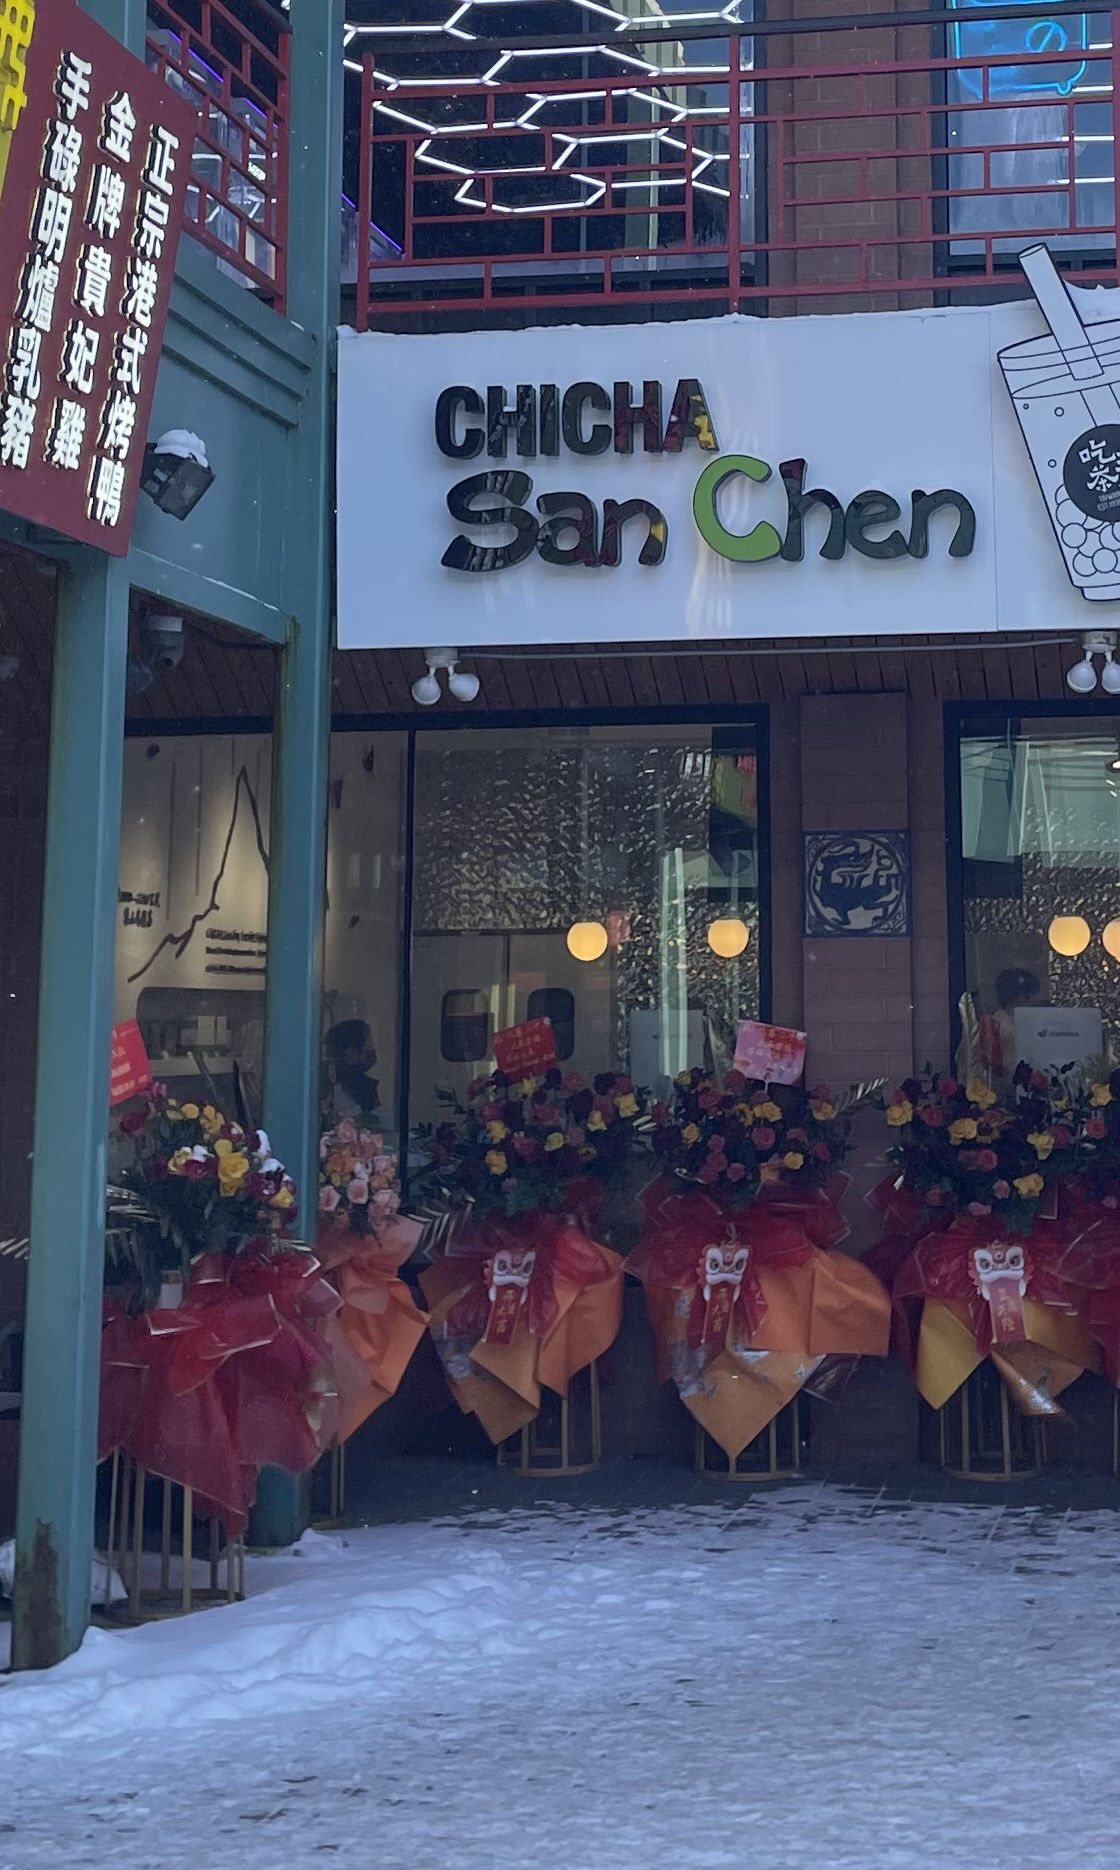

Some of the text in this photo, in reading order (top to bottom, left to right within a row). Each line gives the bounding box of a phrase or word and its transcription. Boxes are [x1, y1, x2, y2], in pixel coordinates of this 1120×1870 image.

[43, 90, 137, 470] 金牌貴妃雞
[88, 123, 180, 527] 正宗港式烤鴨
[434, 378, 720, 458] CHICHA
[440, 454, 977, 573] San Chen
